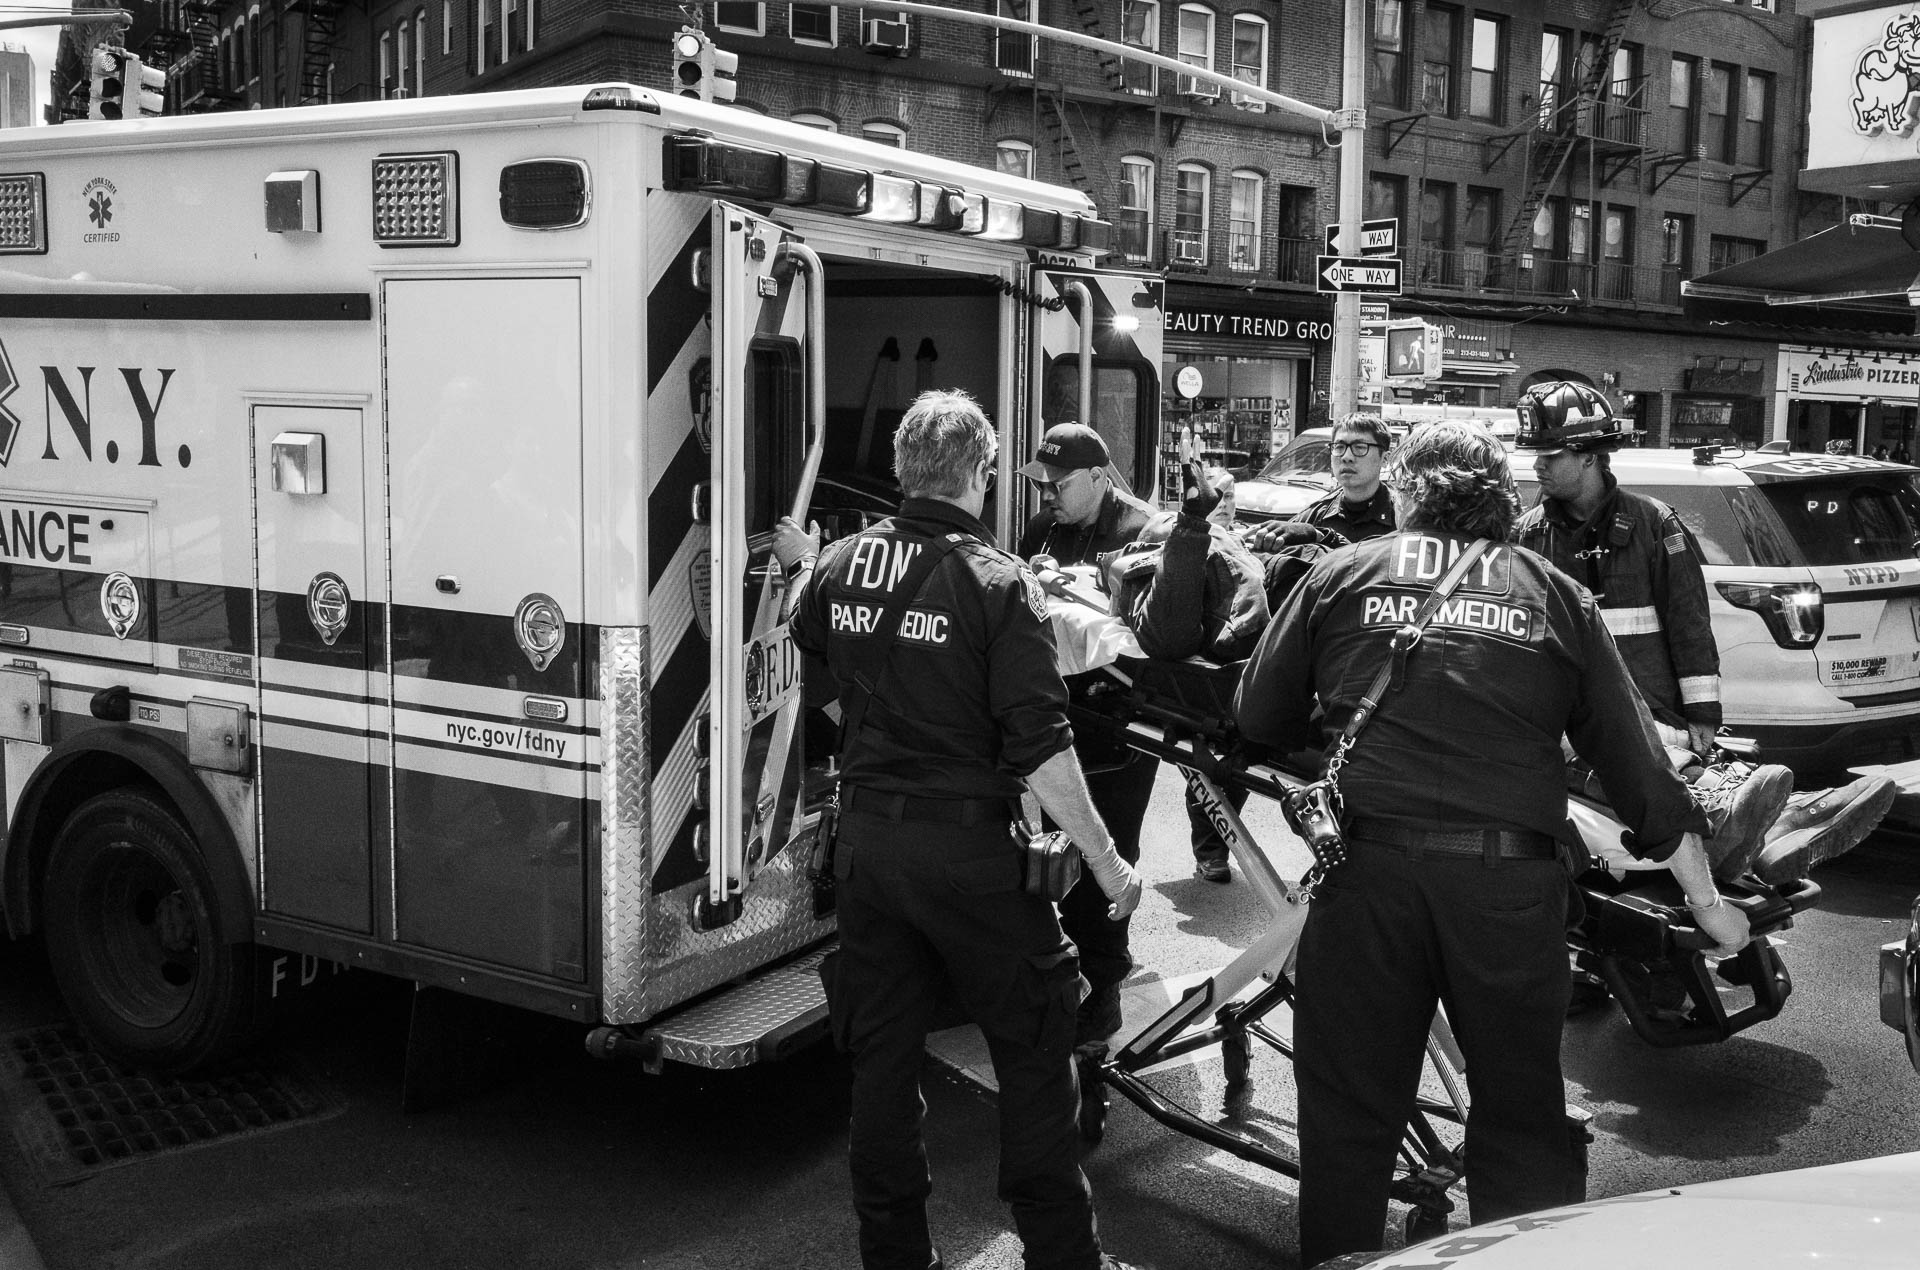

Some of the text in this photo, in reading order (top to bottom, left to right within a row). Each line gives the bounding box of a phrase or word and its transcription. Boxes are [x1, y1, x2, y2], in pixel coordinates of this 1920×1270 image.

[83, 232, 120, 243] CERTIFIED
[1368, 231, 1389, 246] WAY
[1331, 268, 1390, 283] ONE WAY
[1361, 306, 1386, 314] STANDING
[1164, 312, 1332, 340] EAUTY TREND GRO
[1440, 324, 1456, 338] AIR
[1180, 380, 1200, 388] WELLA
[1867, 368, 1919, 385] PIZZER
[1433, 393, 1446, 402] 201
[40, 366, 191, 468] N.Y.
[0, 508, 92, 565] NCE
[846, 537, 922, 592] FDN
[1843, 566, 1900, 586] NYPD
[831, 603, 949, 643] PAREDIC
[1363, 596, 1528, 637] PARMEDIC
[1831, 660, 1860, 672] $10,000
[1831, 673, 1843, 681] CALL
[446, 722, 567, 759] nyc.gov/fdny
[272, 953, 349, 998] FD
